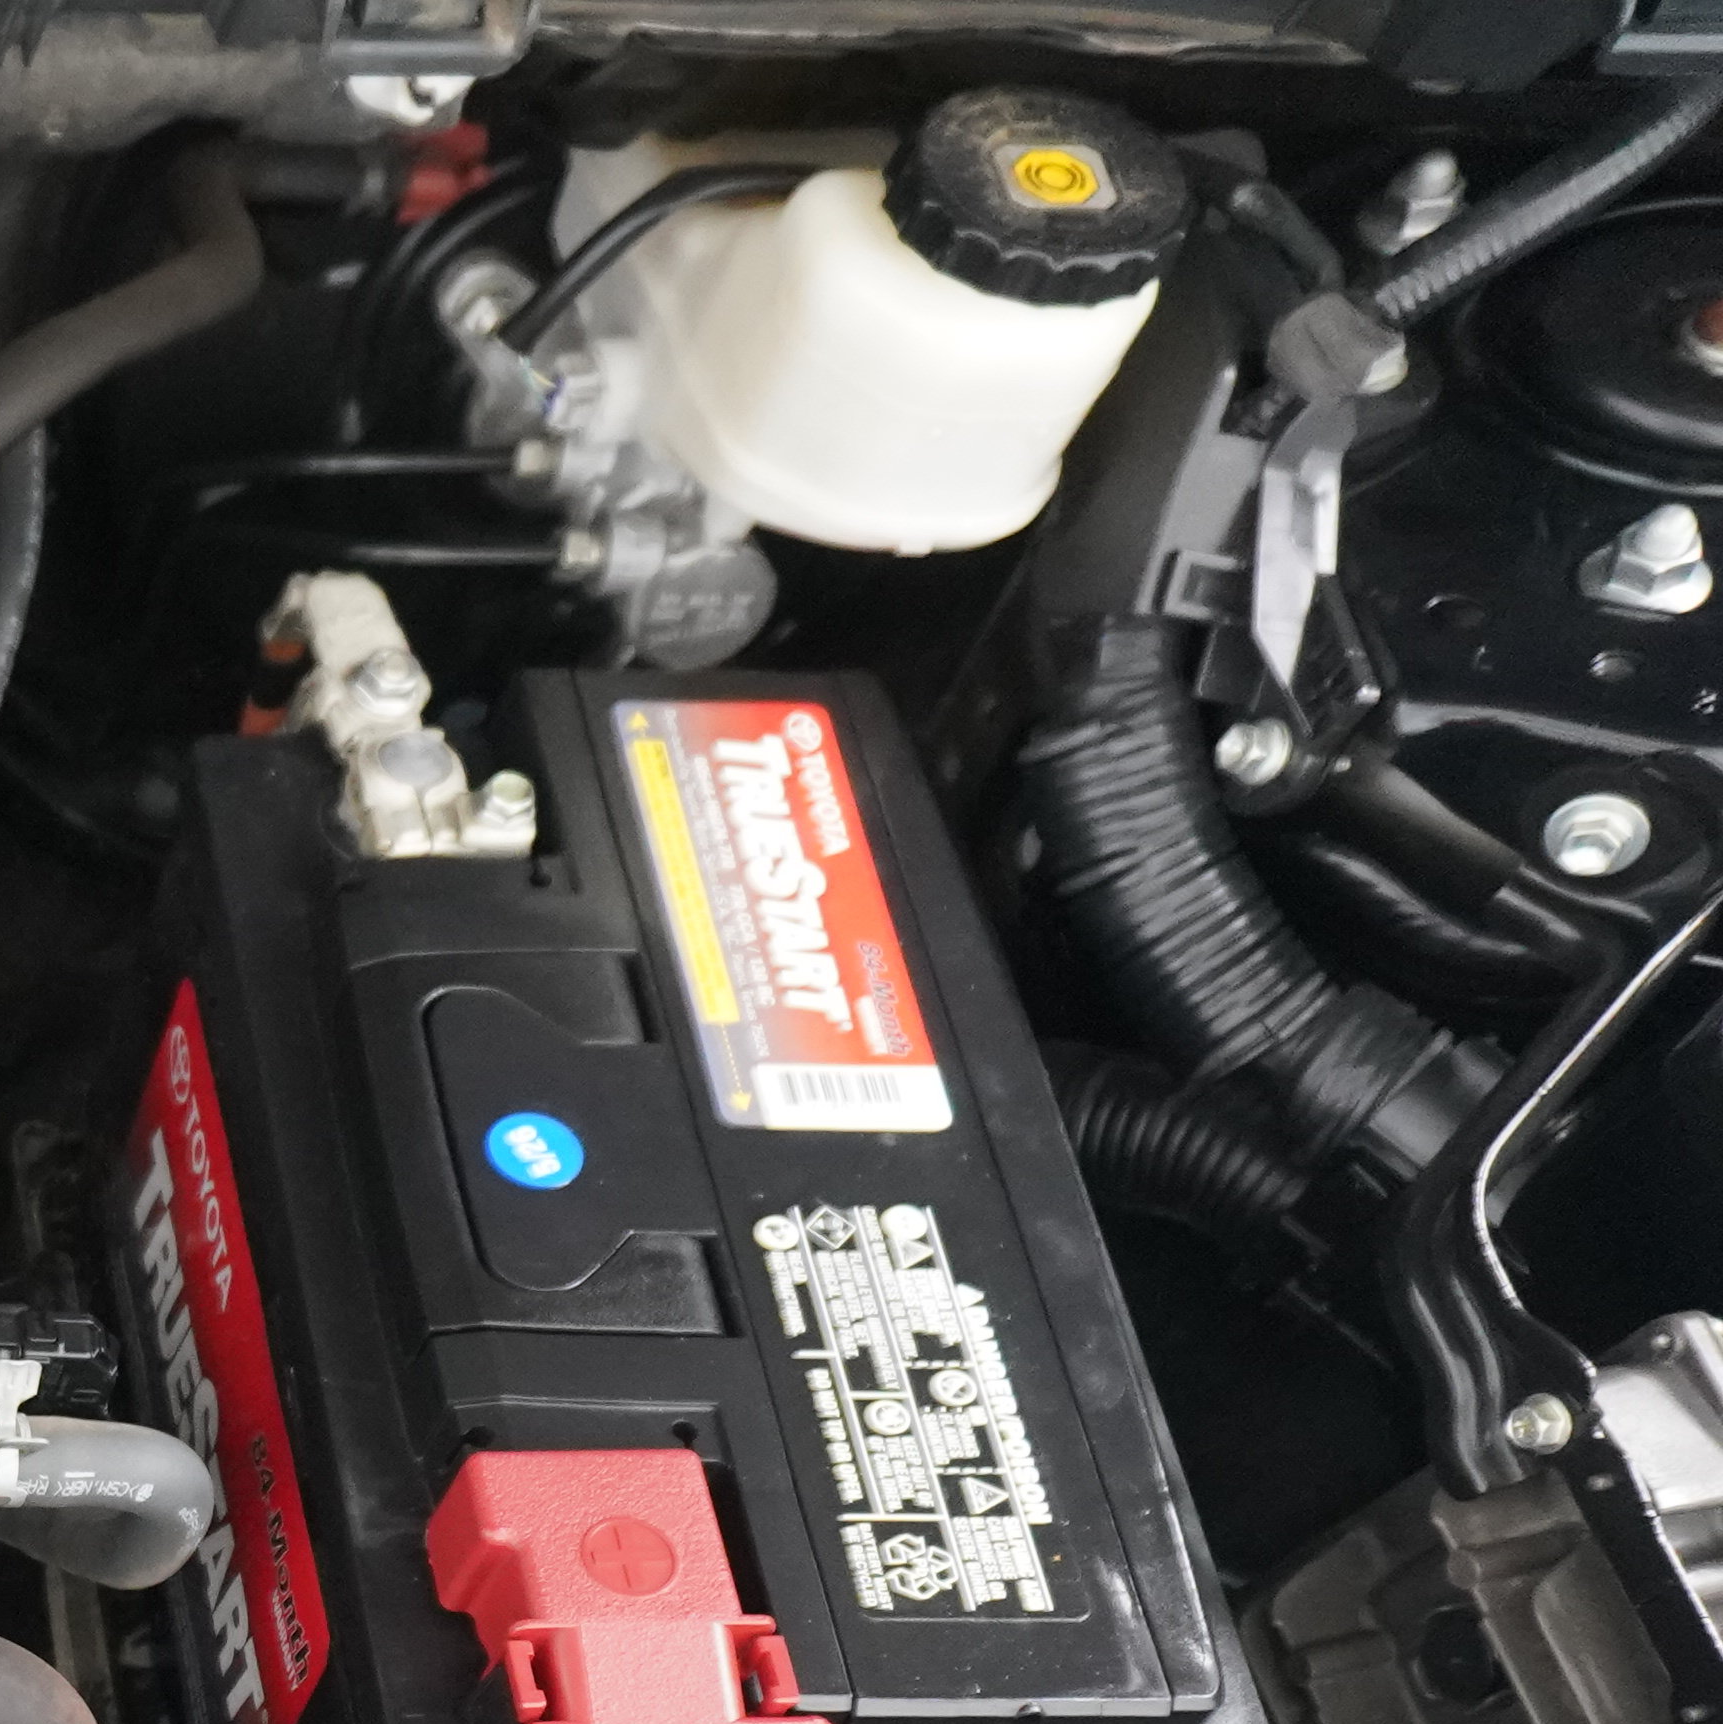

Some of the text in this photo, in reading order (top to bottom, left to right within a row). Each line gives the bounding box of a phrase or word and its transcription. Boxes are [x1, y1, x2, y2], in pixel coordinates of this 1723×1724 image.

[798, 753, 850, 857] TOYOTA
[183, 1098, 233, 1314] TOYOTA
[858, 1206, 884, 1241] CAUSE
[784, 1250, 808, 1284] READ
[812, 1250, 843, 1298] MEDICAL
[846, 1250, 871, 1286] FLUSH
[826, 1299, 851, 1327] HELP
[856, 1287, 879, 1315] EYES
[803, 1367, 833, 1389] DO
[809, 1389, 841, 1418] NOT
[967, 1305, 1052, 1525] DANGER/POISON
[817, 1419, 847, 1441] TIP
[865, 1436, 887, 1453] OF
[823, 1442, 853, 1463] OR
[883, 1436, 916, 1499] THE REACH
[899, 1436, 935, 1508] KEEP OUT OF
[949, 1516, 979, 1560] SEVERE
[983, 1515, 1017, 1580] CAN CAUSE
[839, 1526, 878, 1609] BE RECYCLED
[854, 1522, 894, 1611] BATTERY MUST
